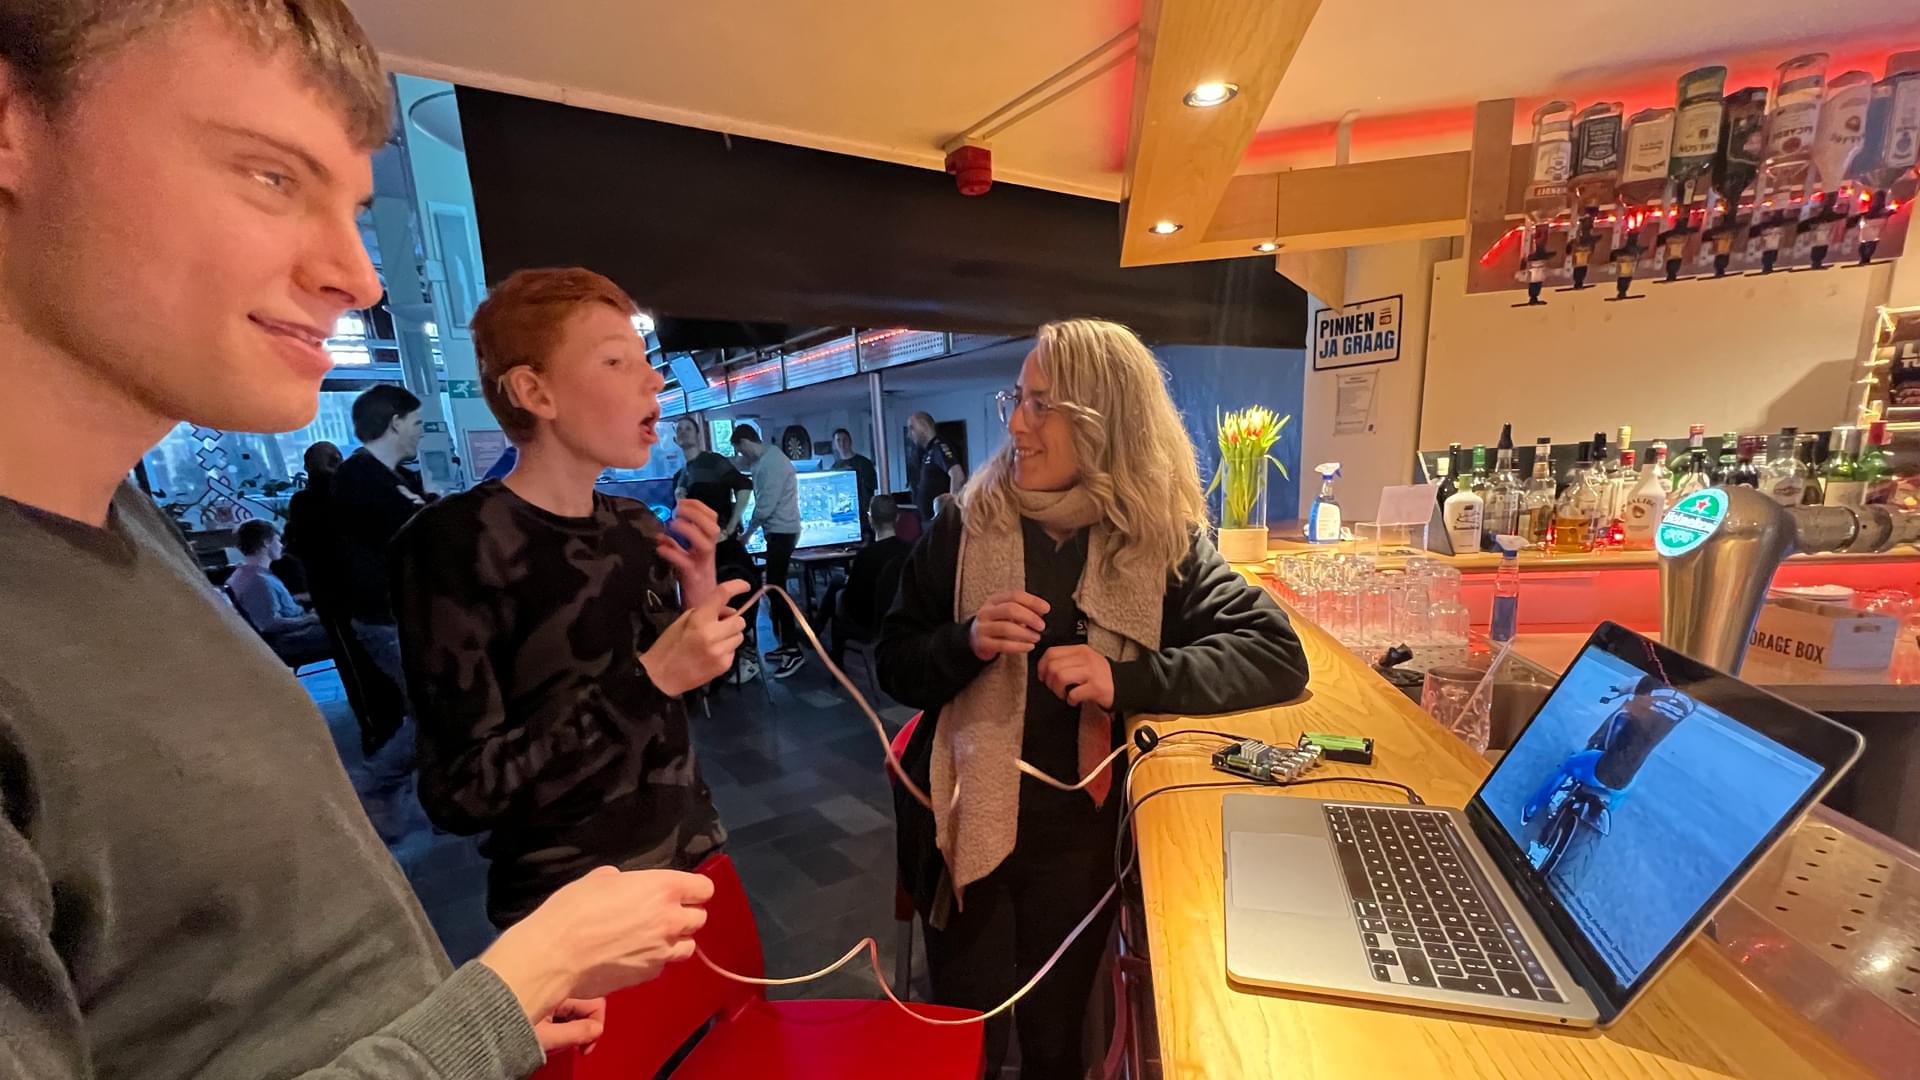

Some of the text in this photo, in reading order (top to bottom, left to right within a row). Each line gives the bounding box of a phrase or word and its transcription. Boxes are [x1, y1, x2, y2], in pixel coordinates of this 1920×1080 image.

[1319, 311, 1375, 339] PINNEN
[1319, 330, 1395, 359] JA GRAAG
[1795, 641, 1825, 665] BOX
